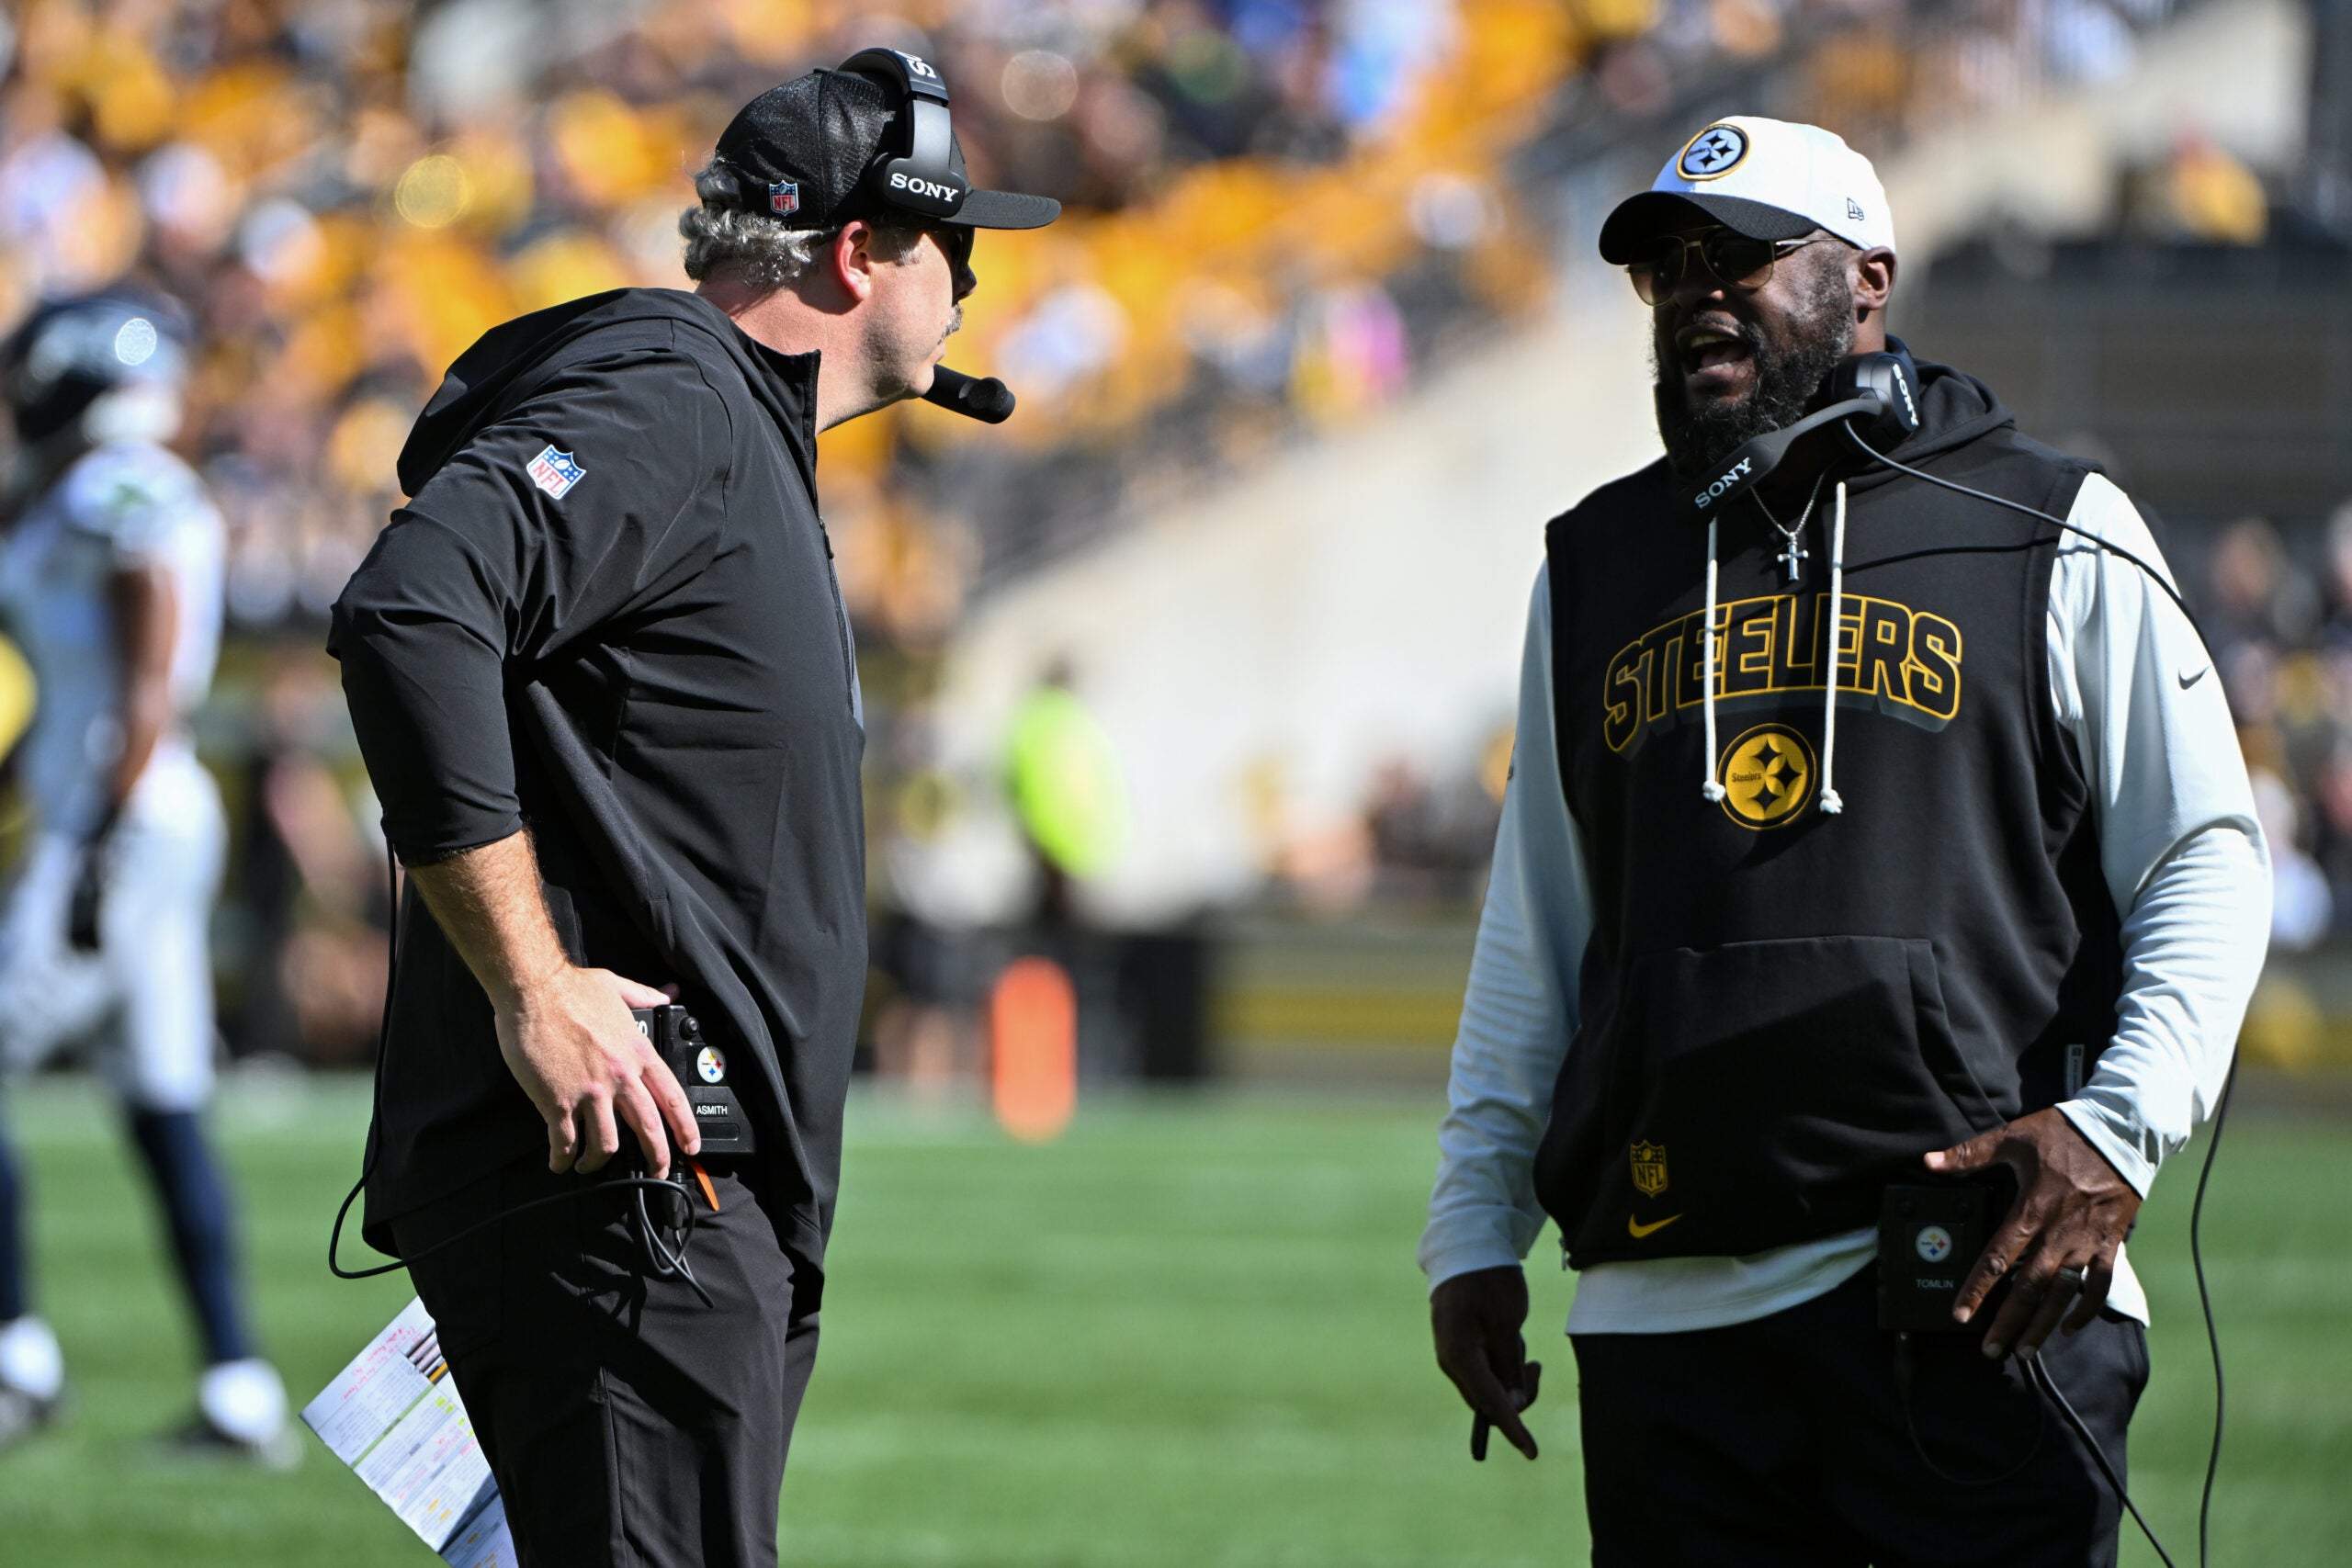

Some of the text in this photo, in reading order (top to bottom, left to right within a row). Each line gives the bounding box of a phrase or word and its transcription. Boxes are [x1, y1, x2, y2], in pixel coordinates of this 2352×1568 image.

[890, 173, 958, 202] SONY
[774, 196, 796, 210] NFL
[1893, 364, 1918, 426] SONY
[532, 461, 565, 494] NFL
[1694, 457, 1752, 509] SONY
[1604, 592, 1962, 753] STEELERS
[696, 1105, 728, 1115] ASMITH
[1635, 1164, 1664, 1189] NFL
[1916, 1279, 1954, 1289] TOMLIN
